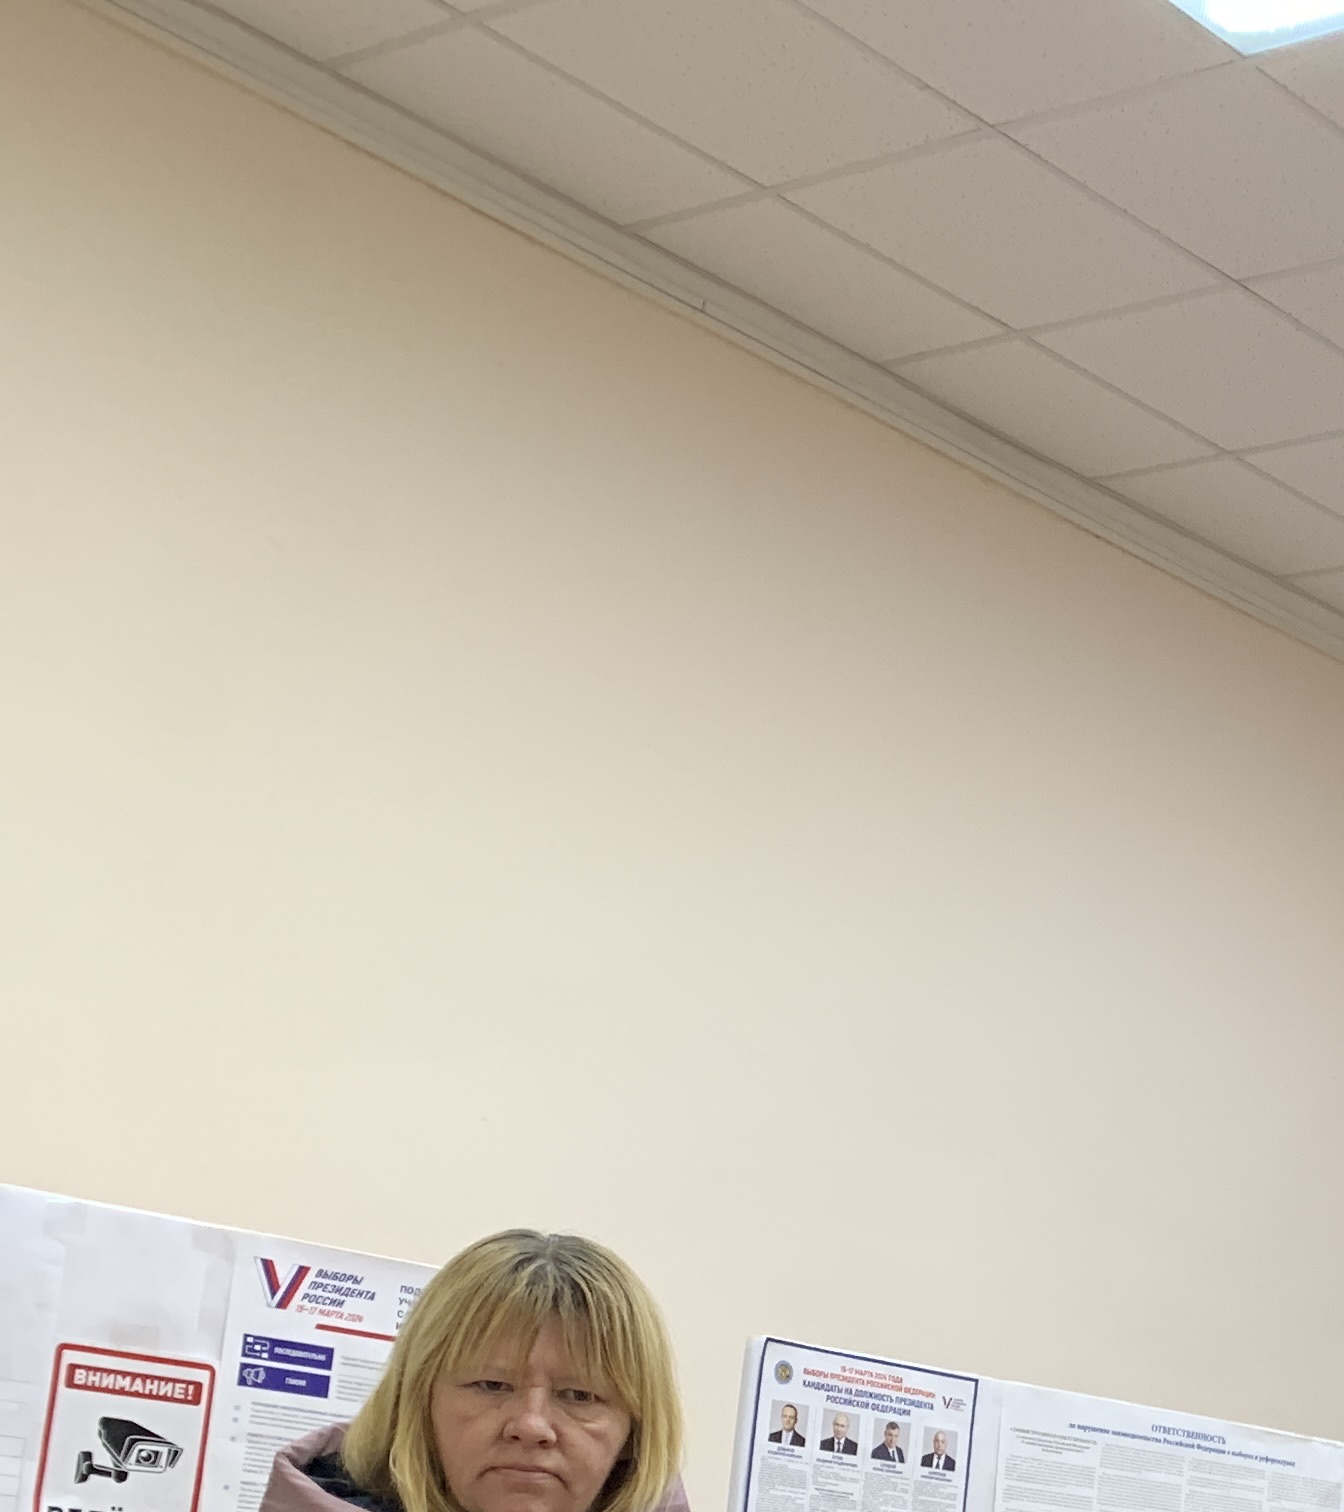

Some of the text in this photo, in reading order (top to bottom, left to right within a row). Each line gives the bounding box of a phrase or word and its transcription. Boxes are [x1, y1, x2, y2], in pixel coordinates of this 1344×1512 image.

[314, 1269, 364, 1286] ВЫБОРЫ
[308, 1281, 376, 1301] ПРЕЗИДЕНТА
[301, 1293, 345, 1309] РОССИИ
[73, 1369, 195, 1400] ВНИМАНИЕ!
[802, 1379, 844, 1394] КАНДИДАТЫ
[1151, 1424, 1227, 1445] ОТВЕТСТВЕННОСТЬ
